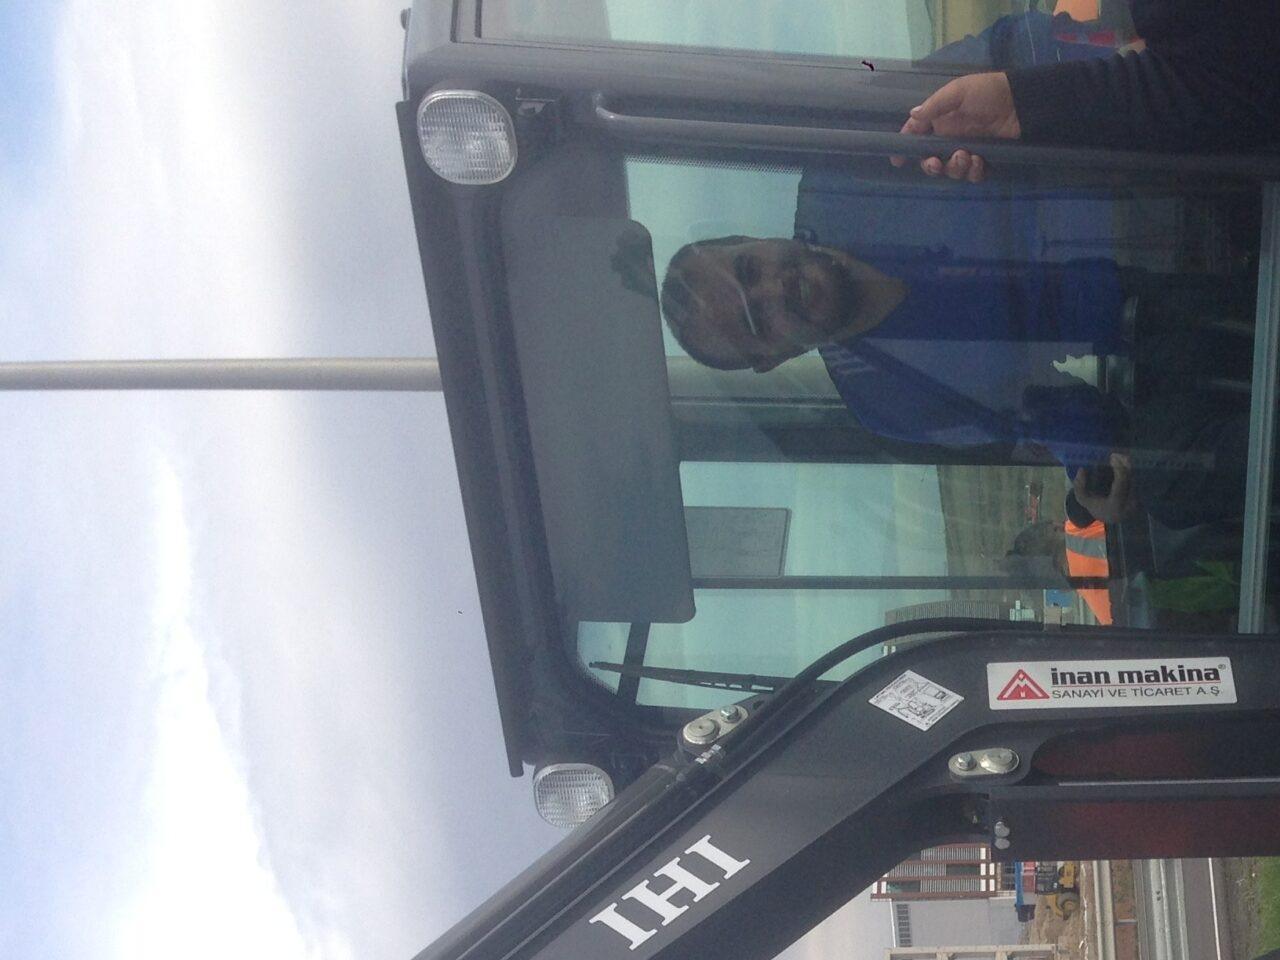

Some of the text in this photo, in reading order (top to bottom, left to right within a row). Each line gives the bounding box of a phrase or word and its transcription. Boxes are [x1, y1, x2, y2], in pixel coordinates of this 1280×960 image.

[1051, 667, 1111, 686] inan
[1052, 687, 1104, 699] SANAYİ
[1110, 687, 1128, 698] VE
[1134, 686, 1191, 698] TİCARET
[588, 834, 751, 951] IHI
